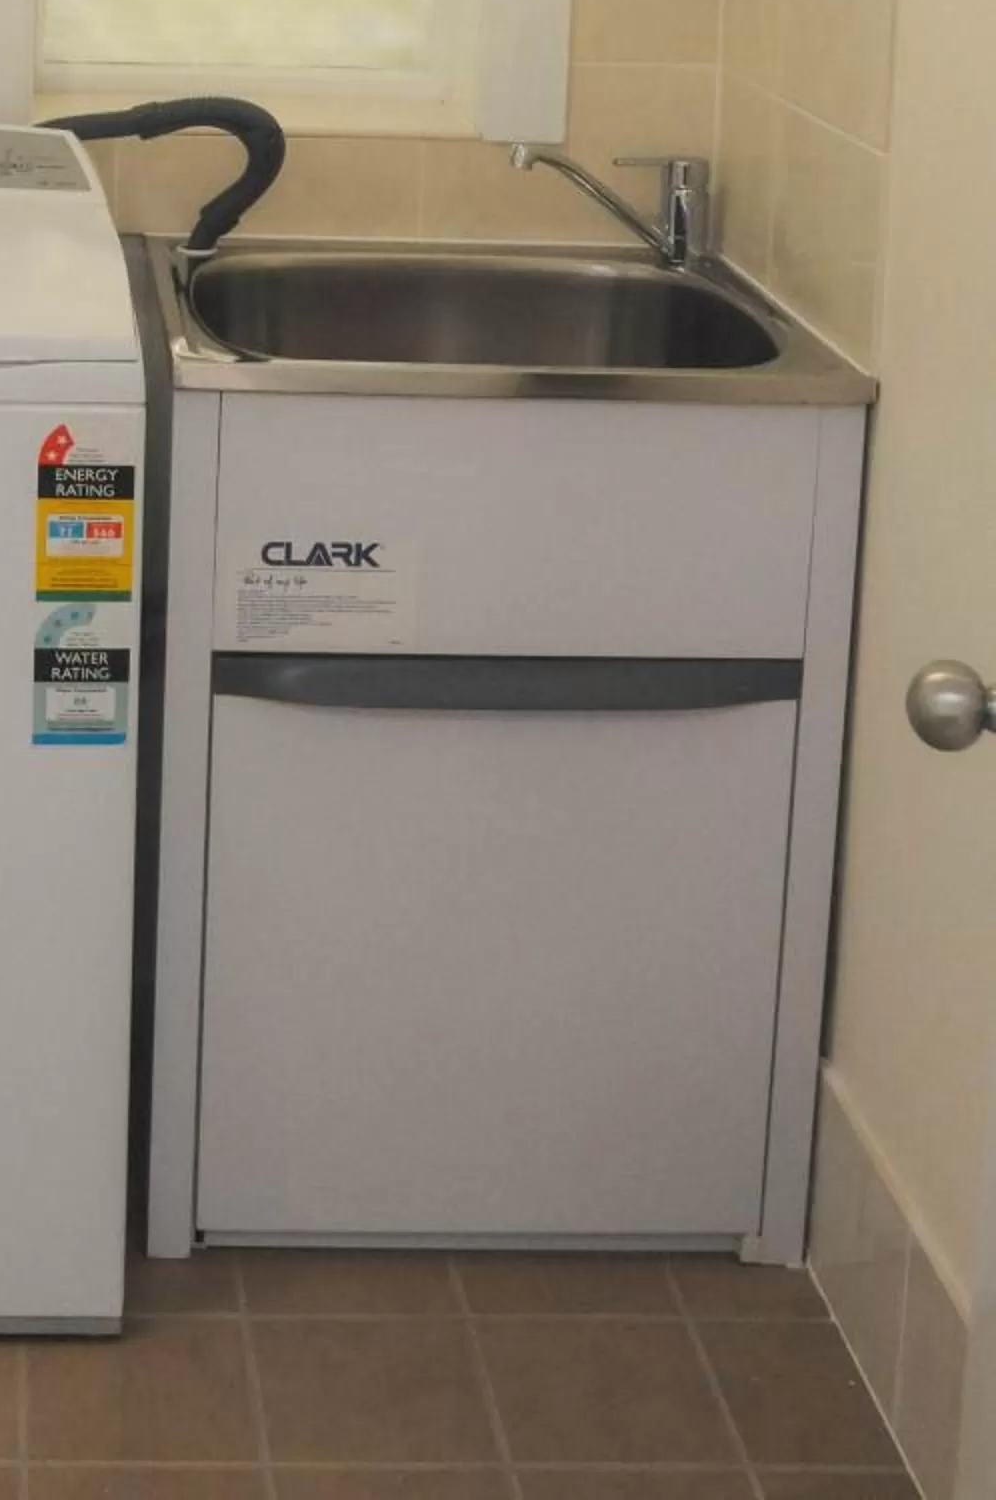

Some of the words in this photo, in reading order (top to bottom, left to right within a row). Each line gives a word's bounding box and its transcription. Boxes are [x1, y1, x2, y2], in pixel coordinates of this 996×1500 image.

[55, 468, 119, 482] ENERGY
[55, 484, 116, 498] RATING
[261, 541, 380, 568] CLARK
[55, 651, 109, 665] WATER
[51, 667, 110, 681] RATING
